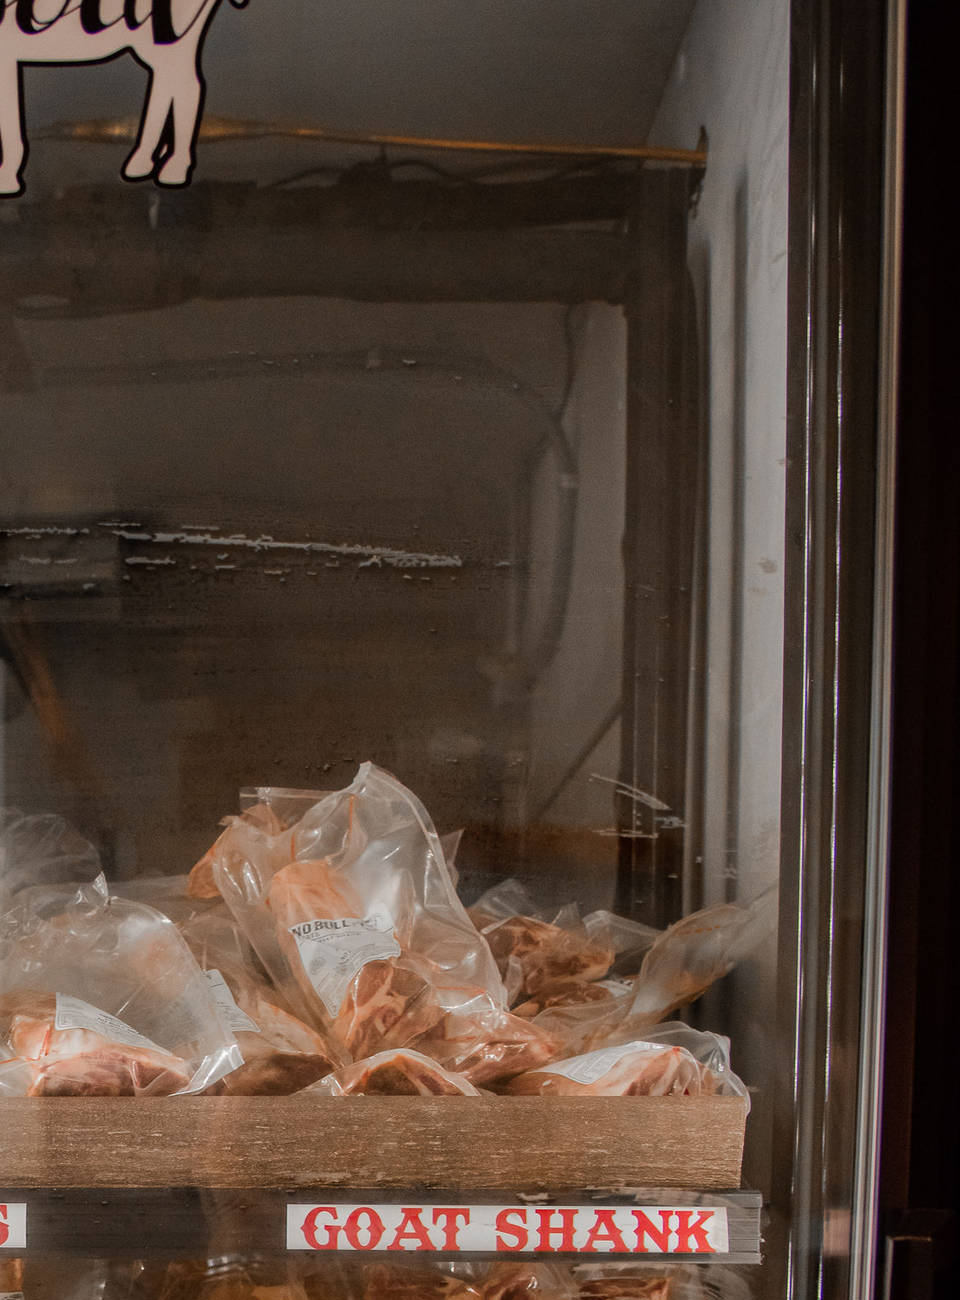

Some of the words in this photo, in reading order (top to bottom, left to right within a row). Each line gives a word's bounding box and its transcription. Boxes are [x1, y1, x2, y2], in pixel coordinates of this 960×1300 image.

[291, 924, 311, 937] NO
[315, 919, 351, 931] BULL
[300, 1206, 470, 1251] GOAT
[496, 1208, 716, 1253] SHANK
